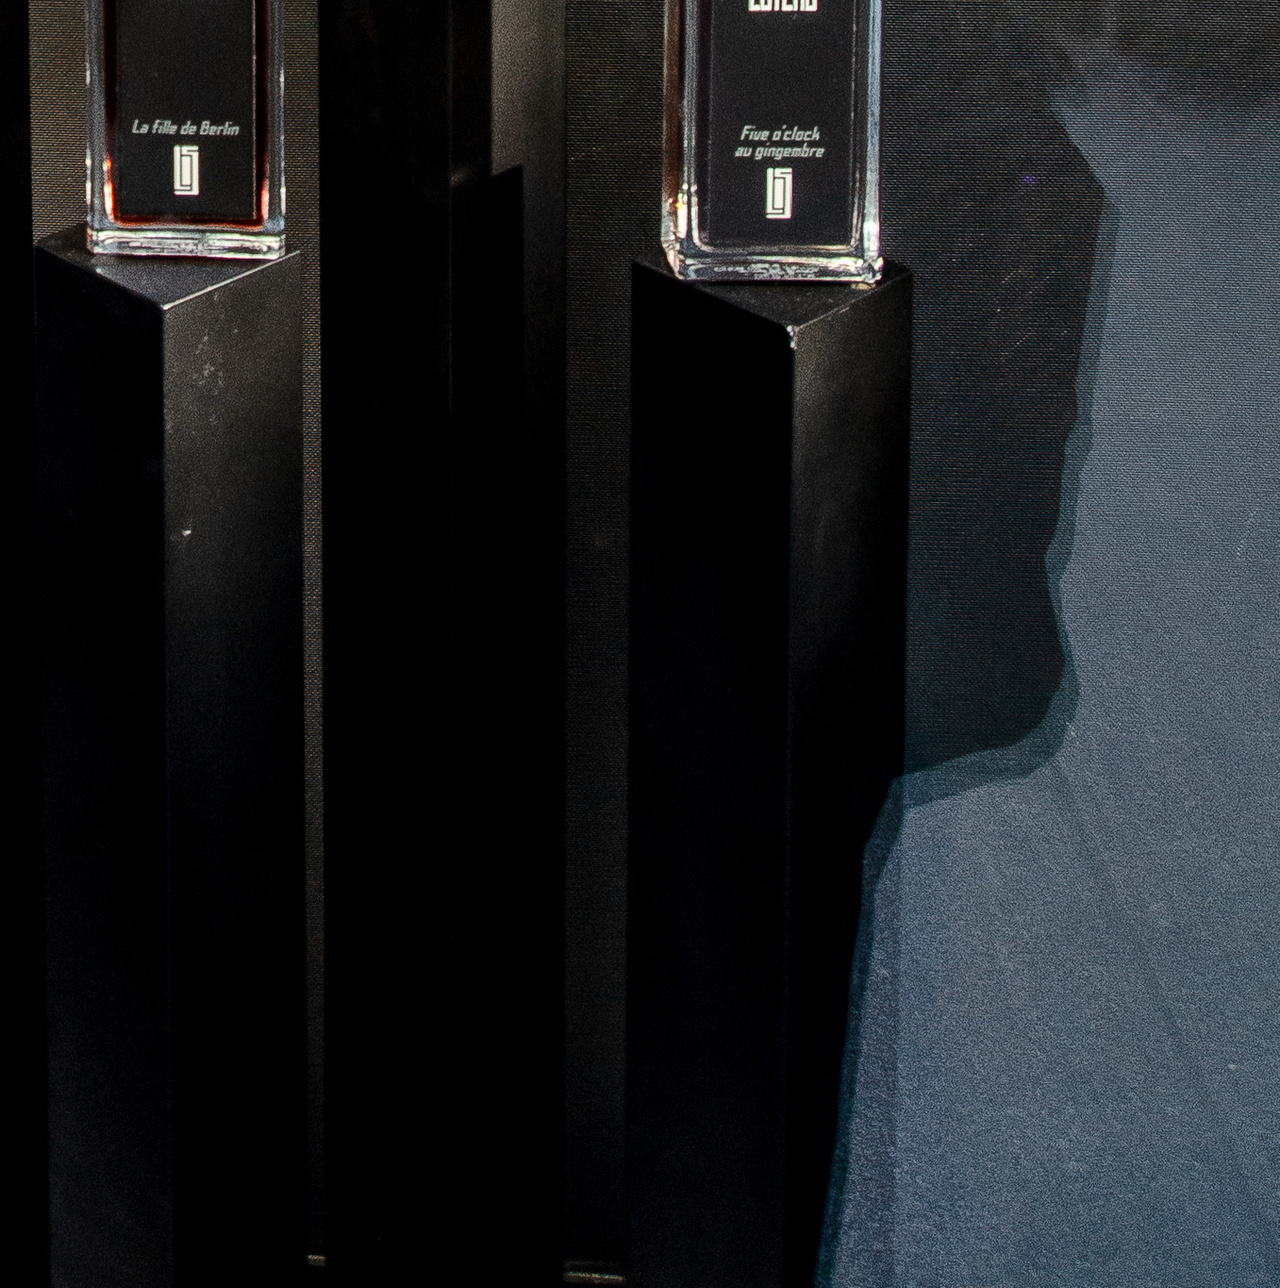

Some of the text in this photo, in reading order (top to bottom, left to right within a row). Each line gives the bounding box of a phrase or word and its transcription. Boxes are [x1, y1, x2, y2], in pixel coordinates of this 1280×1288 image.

[131, 118, 150, 134] La
[180, 120, 197, 135] de
[199, 120, 240, 136] Berlin
[740, 125, 771, 141] Five
[734, 142, 825, 160] au gingembre
